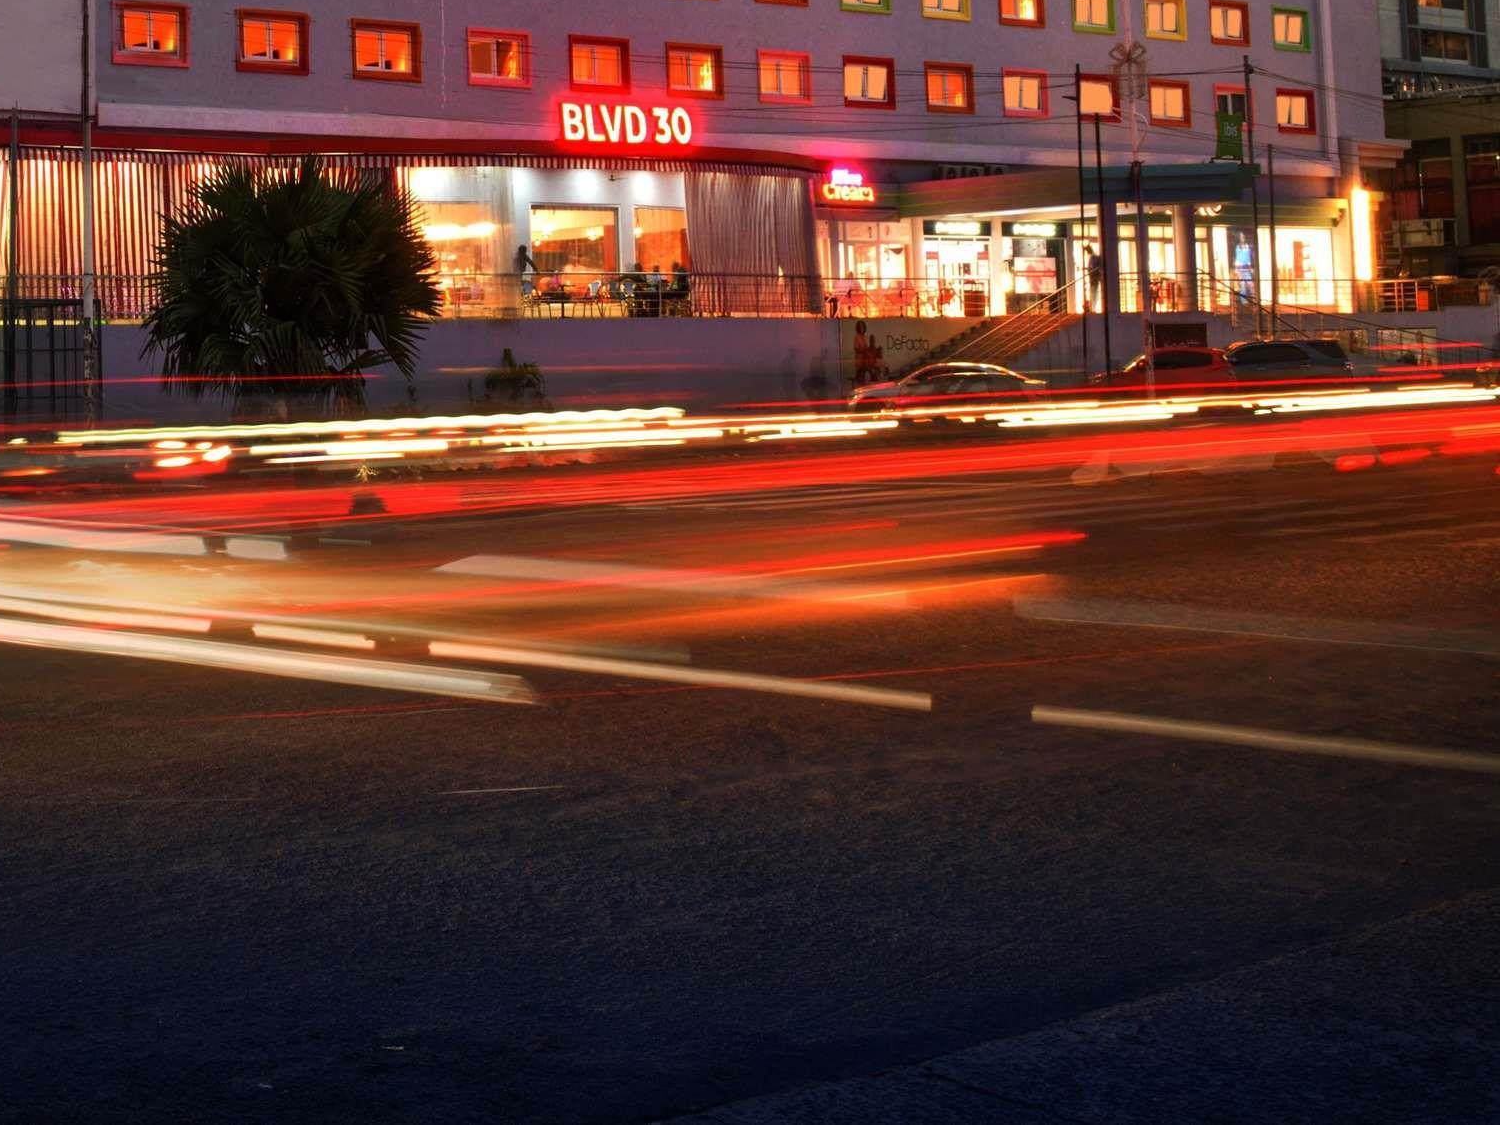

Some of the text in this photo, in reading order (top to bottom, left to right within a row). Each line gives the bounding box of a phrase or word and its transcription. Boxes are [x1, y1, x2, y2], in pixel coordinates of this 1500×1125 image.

[561, 102, 692, 145] BLVD 30
[886, 334, 930, 352] DeFacto
